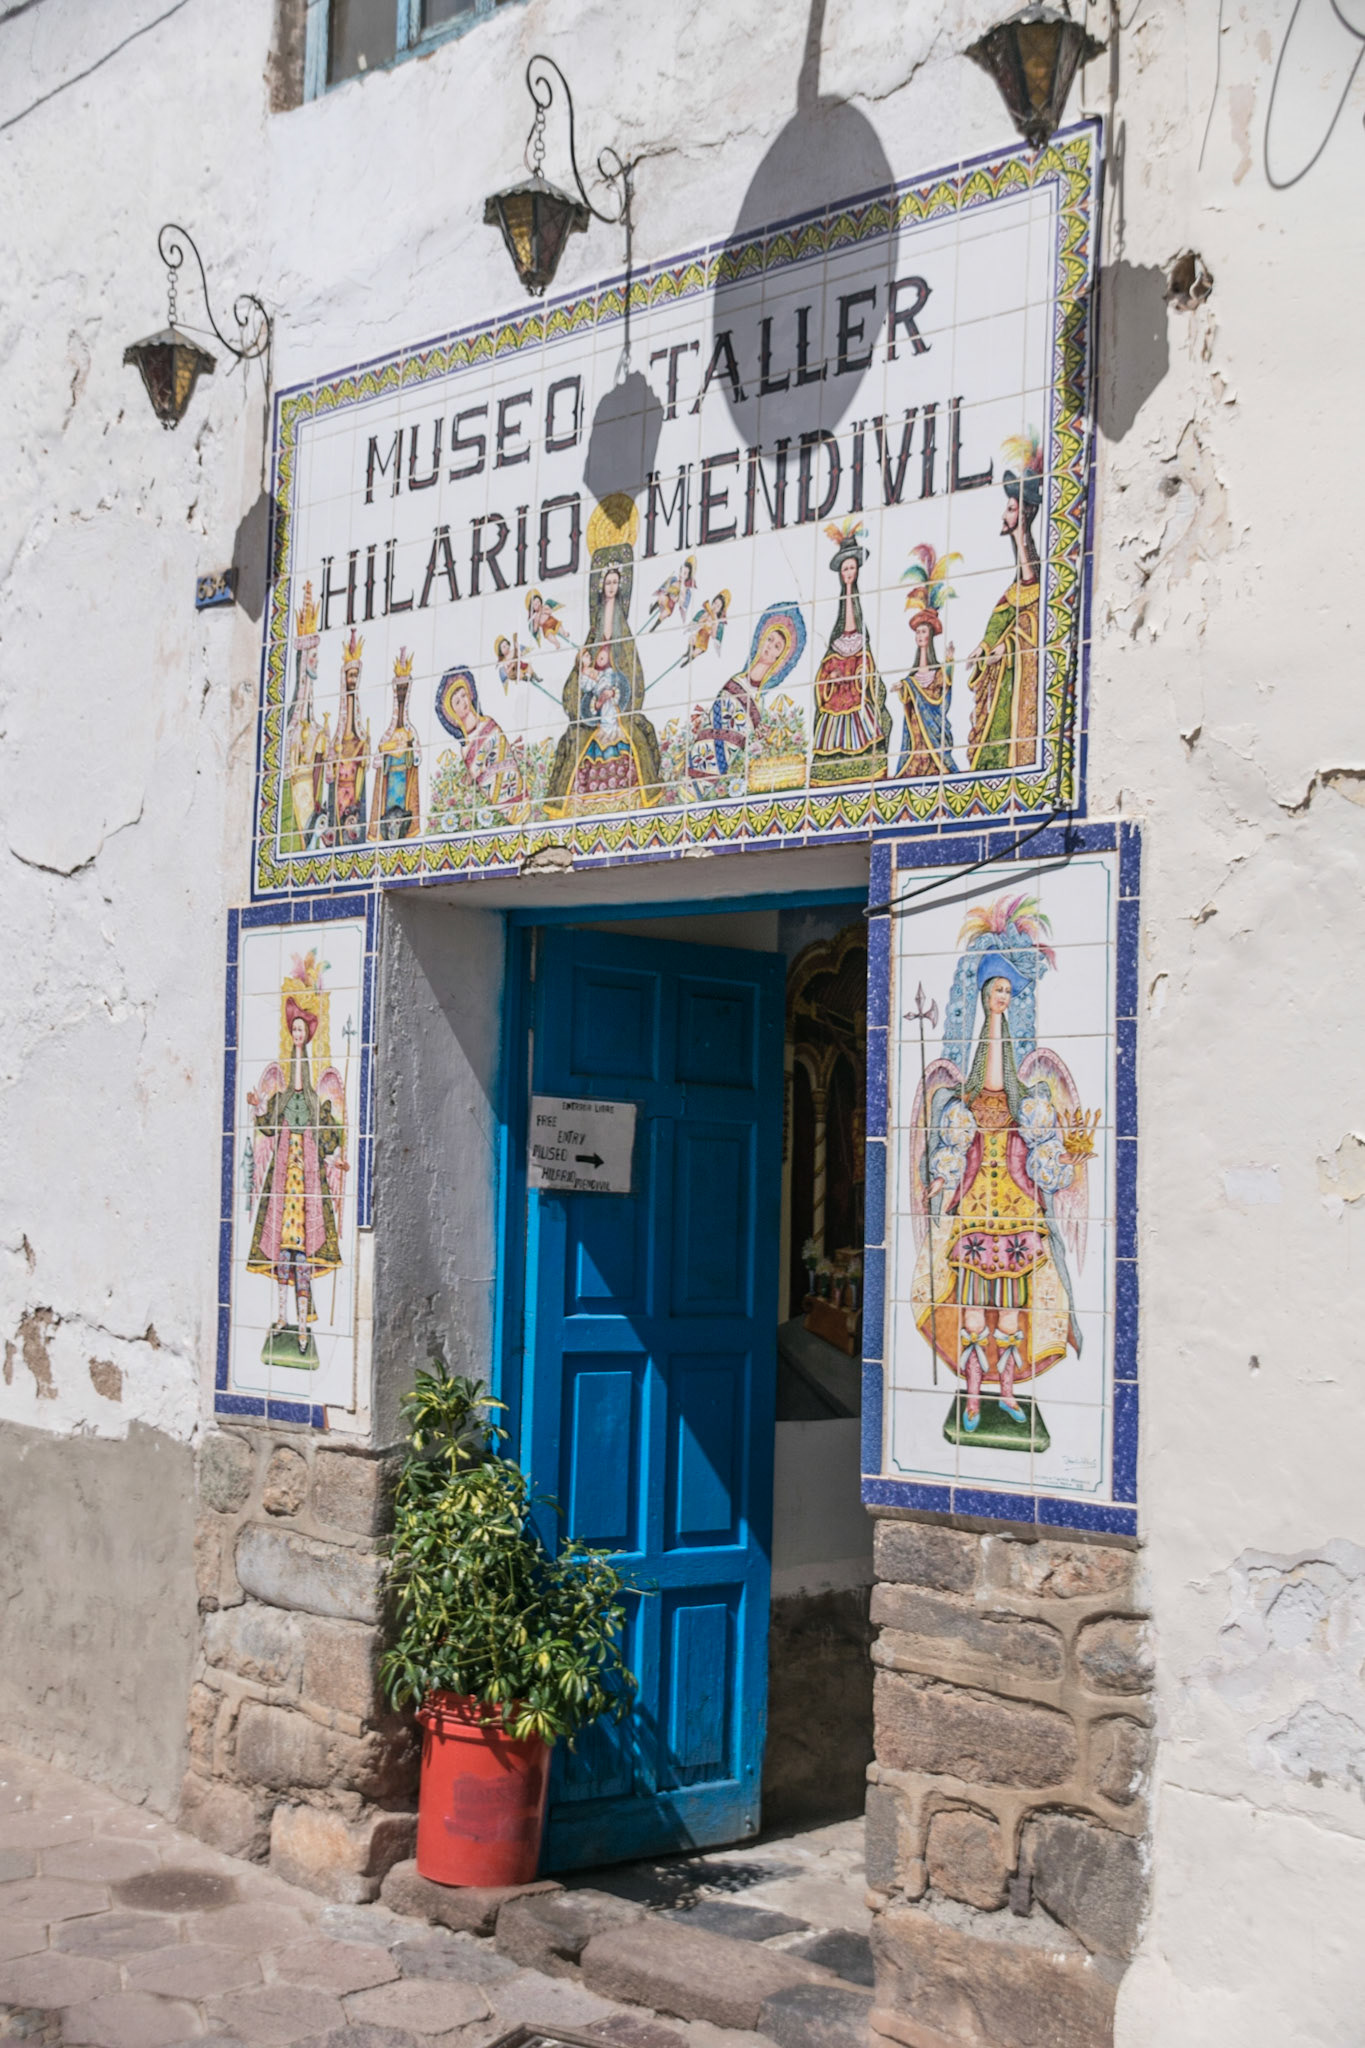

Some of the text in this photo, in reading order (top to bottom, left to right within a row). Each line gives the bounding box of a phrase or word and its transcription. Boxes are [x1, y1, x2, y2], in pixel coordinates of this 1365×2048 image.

[364, 275, 932, 505] MUSEO TALLER
[320, 396, 994, 632] HILARIO MENDIVIL
[536, 1114, 558, 1128] FREE
[557, 1130, 586, 1146] ENTRY
[532, 1144, 569, 1162] MUSEO
